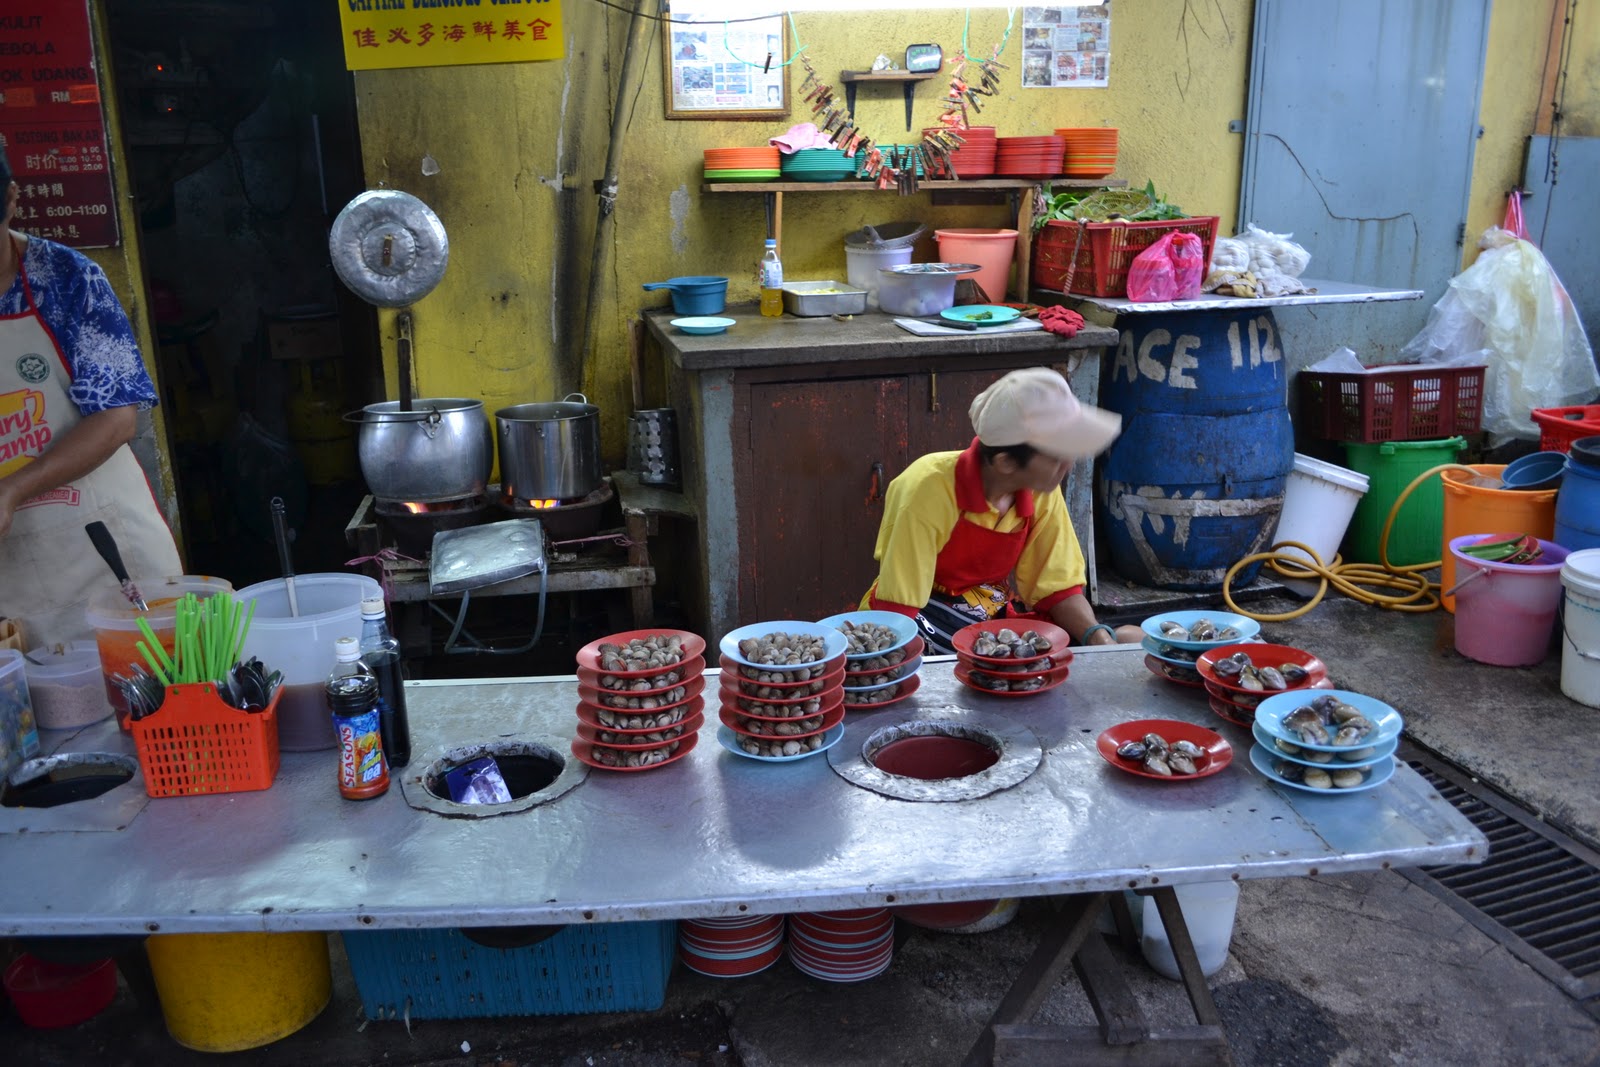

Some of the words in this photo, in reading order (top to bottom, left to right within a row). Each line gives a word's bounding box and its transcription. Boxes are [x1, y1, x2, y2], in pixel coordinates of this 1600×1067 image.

[32, 67, 88, 80] UDANG
[26, 154, 58, 170] 时价
[343, 727, 354, 786] SEASONS
[363, 763, 381, 782] tea
